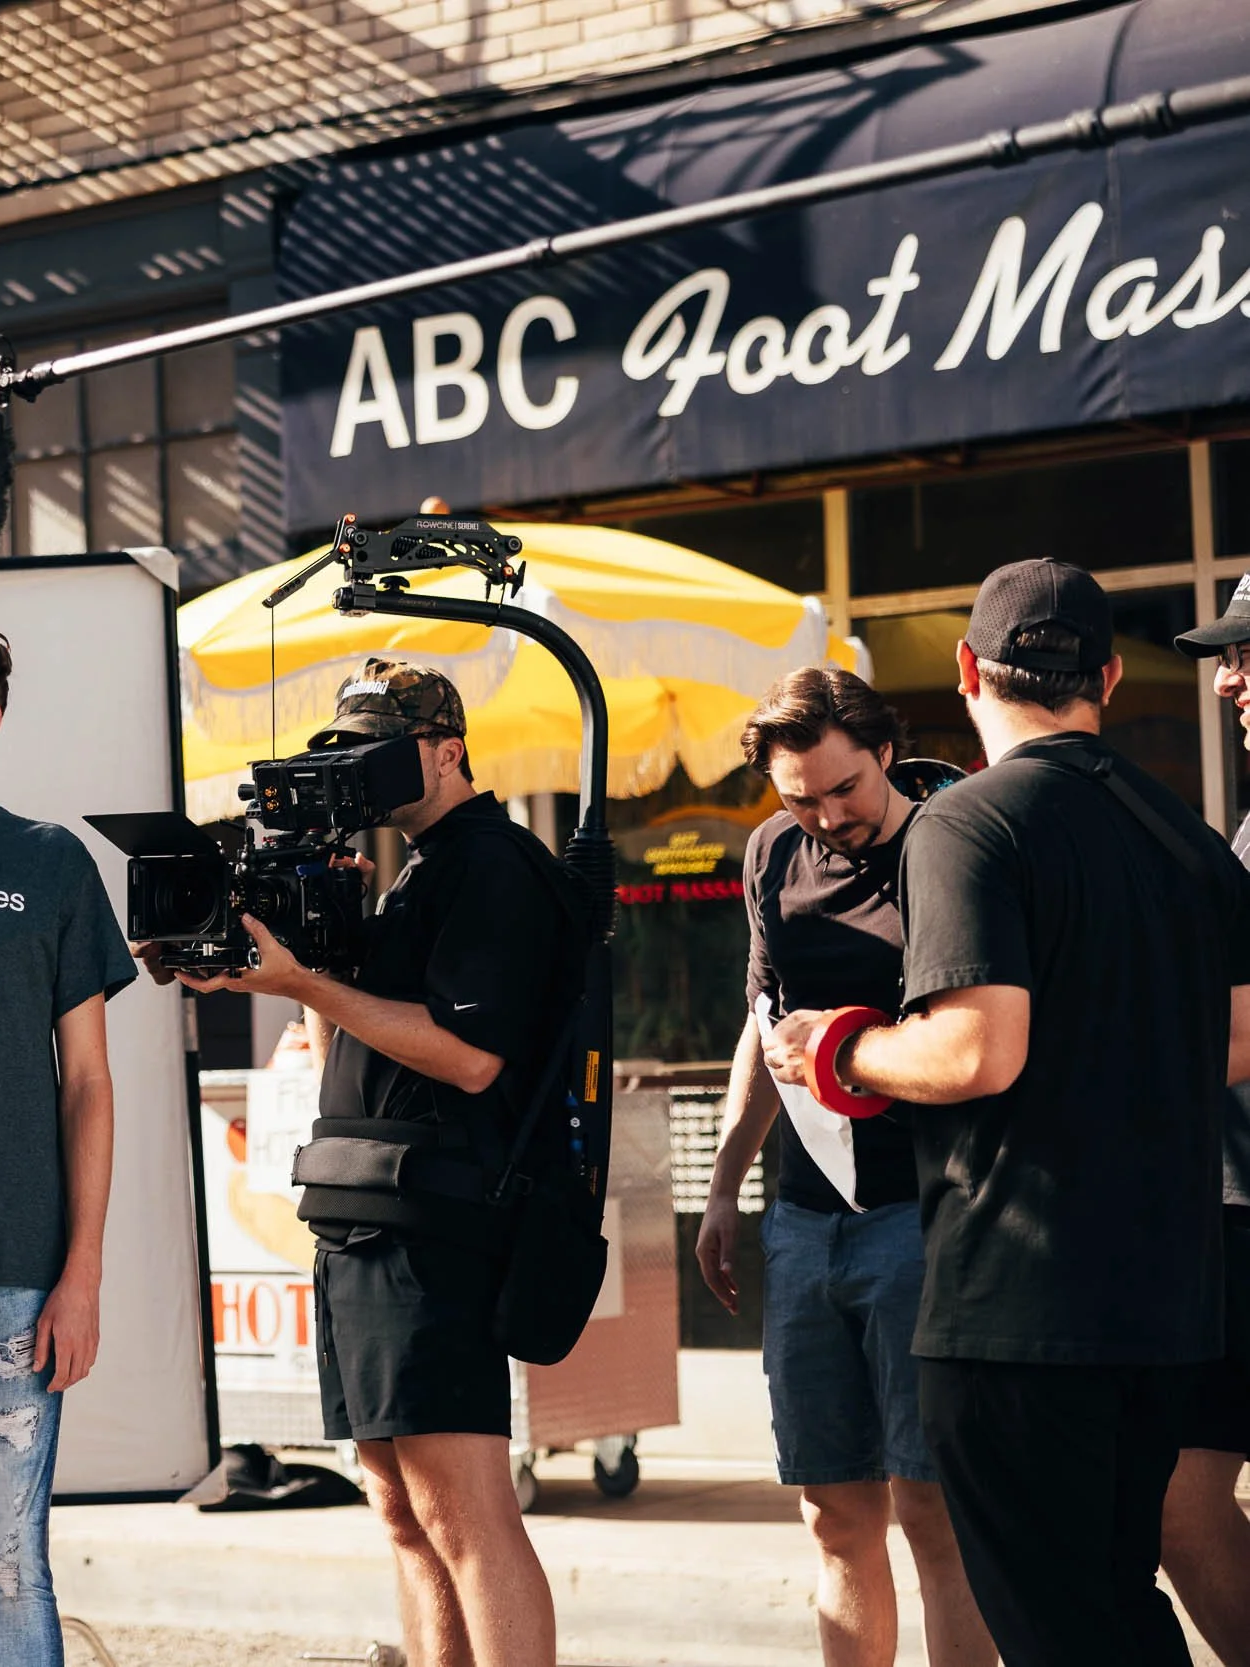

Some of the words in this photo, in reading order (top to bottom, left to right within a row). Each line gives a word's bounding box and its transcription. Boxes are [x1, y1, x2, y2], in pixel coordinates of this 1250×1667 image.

[329, 296, 579, 457] ABC
[621, 233, 920, 416] Foot
[933, 201, 1250, 372] Mas
[211, 1281, 316, 1347] HOT
